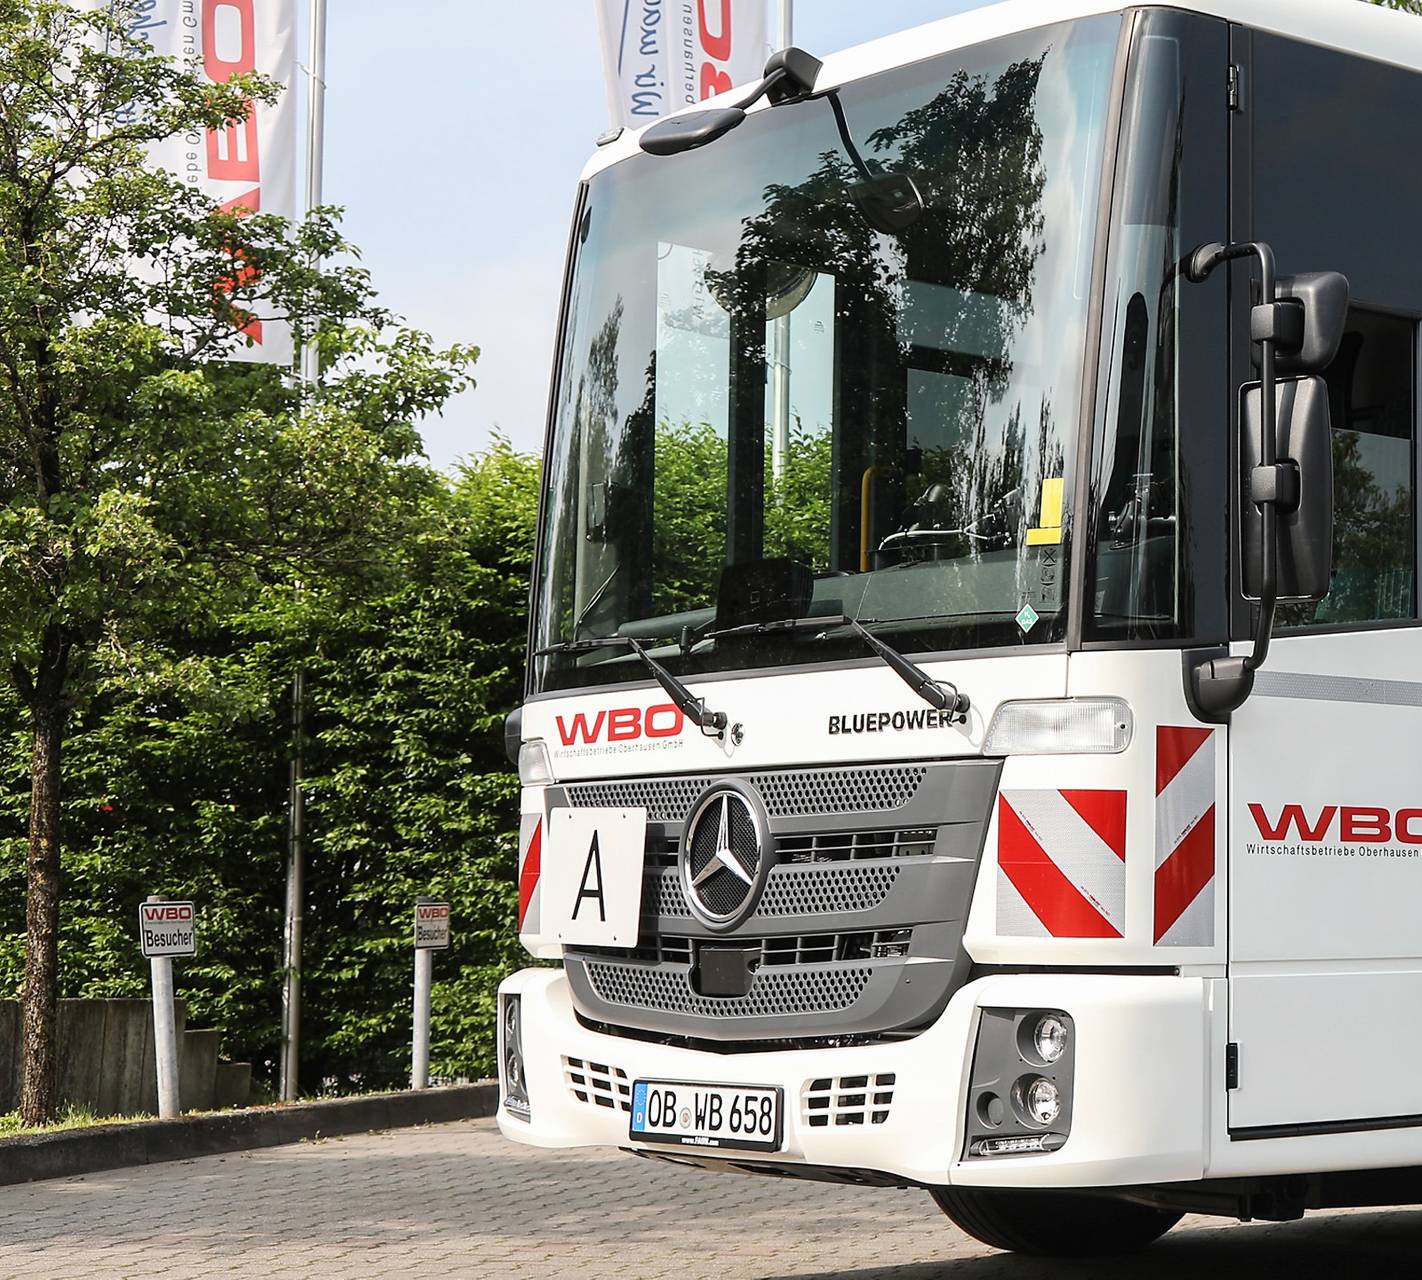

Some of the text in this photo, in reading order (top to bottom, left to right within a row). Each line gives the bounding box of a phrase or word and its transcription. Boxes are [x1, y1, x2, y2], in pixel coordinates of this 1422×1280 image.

[555, 703, 685, 747] WBO
[828, 708, 953, 735] BLUEPOWER
[1246, 843, 1356, 857] Wirtschaftsbetriebe
[1358, 846, 1419, 858] Oberhausen
[571, 829, 606, 922] A
[144, 907, 192, 921] WBO
[419, 907, 449, 918] WBO
[145, 929, 193, 947] Besucher
[636, 1112, 643, 1123] D
[648, 1089, 677, 1128] OB
[694, 1092, 723, 1131] WB
[729, 1094, 773, 1136] 658
